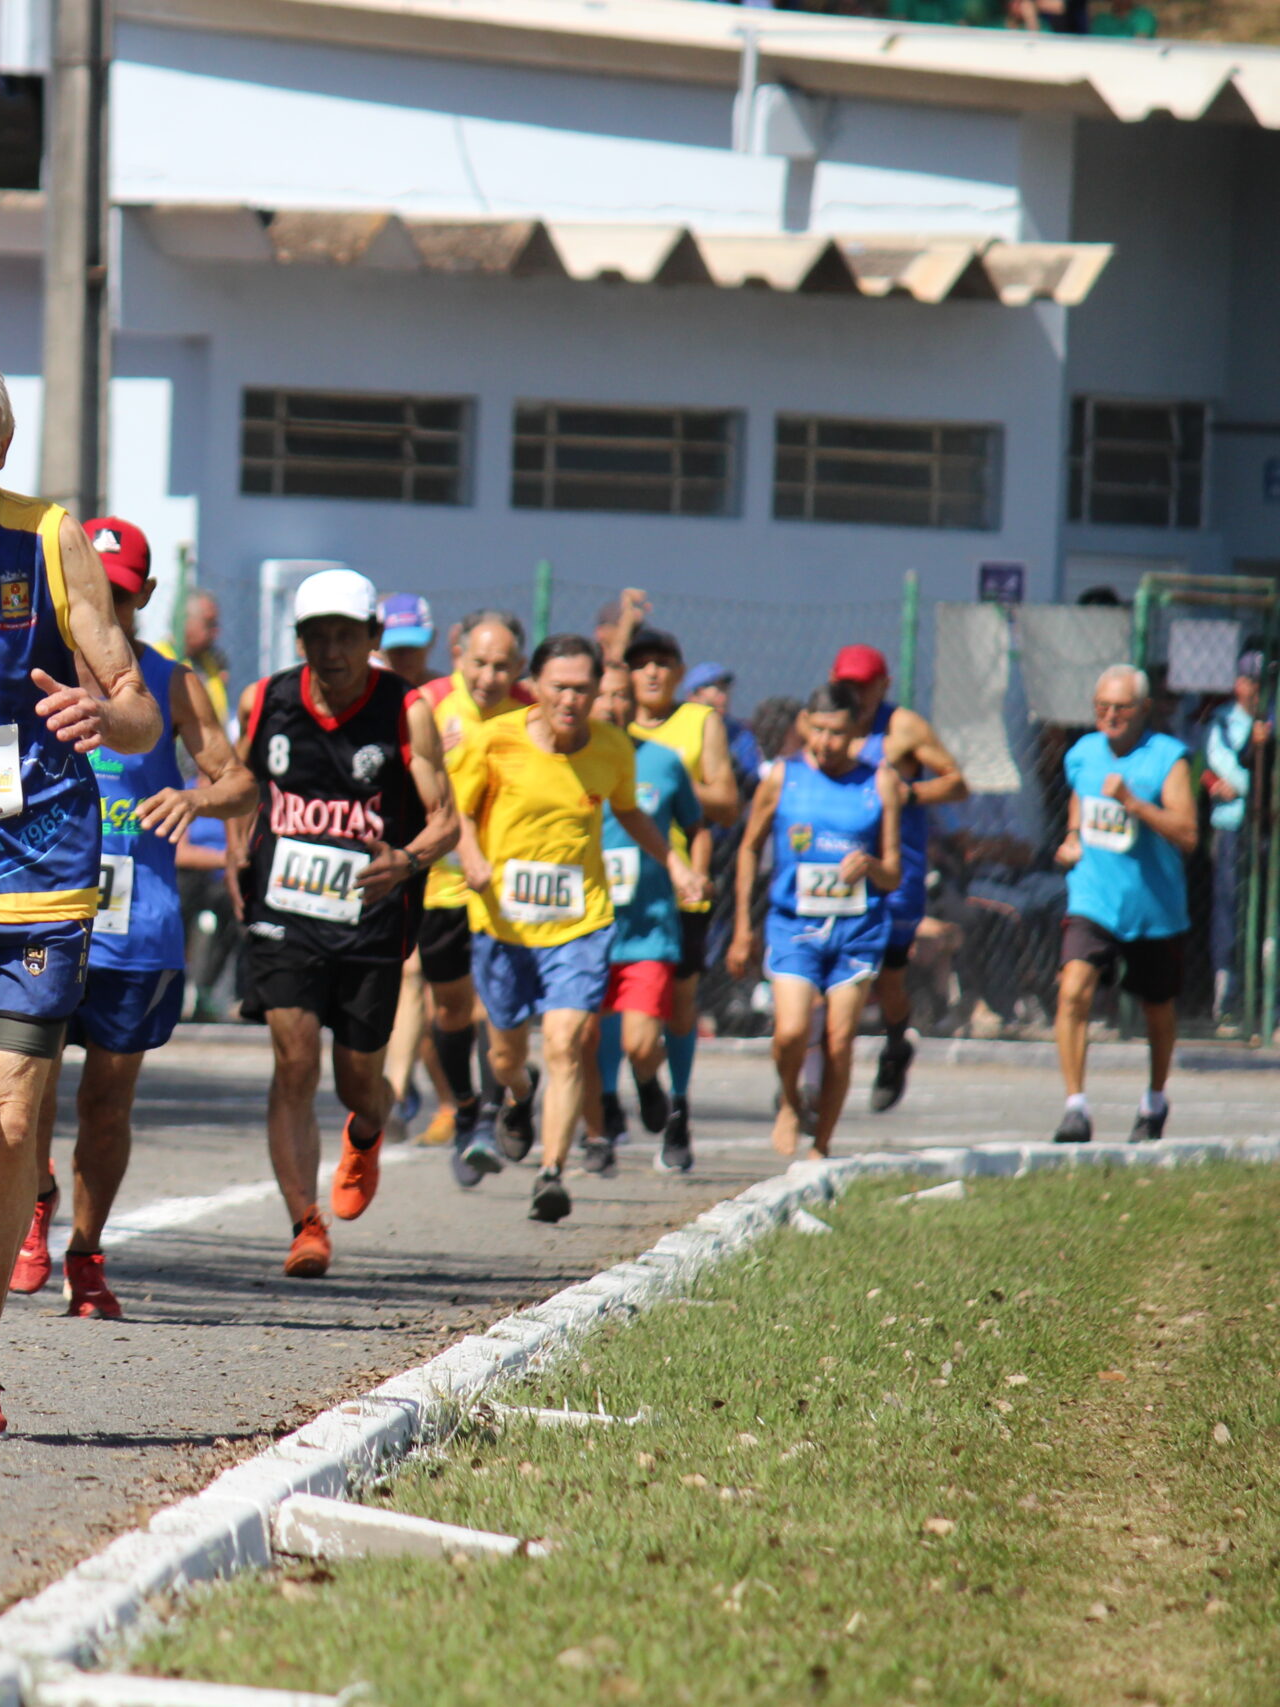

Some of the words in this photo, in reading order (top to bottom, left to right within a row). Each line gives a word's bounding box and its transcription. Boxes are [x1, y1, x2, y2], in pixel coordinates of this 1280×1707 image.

[268, 734, 290, 775] 8
[20, 803, 70, 848] 1965
[268, 780, 384, 841] BROTAS
[282, 851, 353, 900] 004
[516, 872, 570, 907] 006
[810, 869, 853, 897] 22
